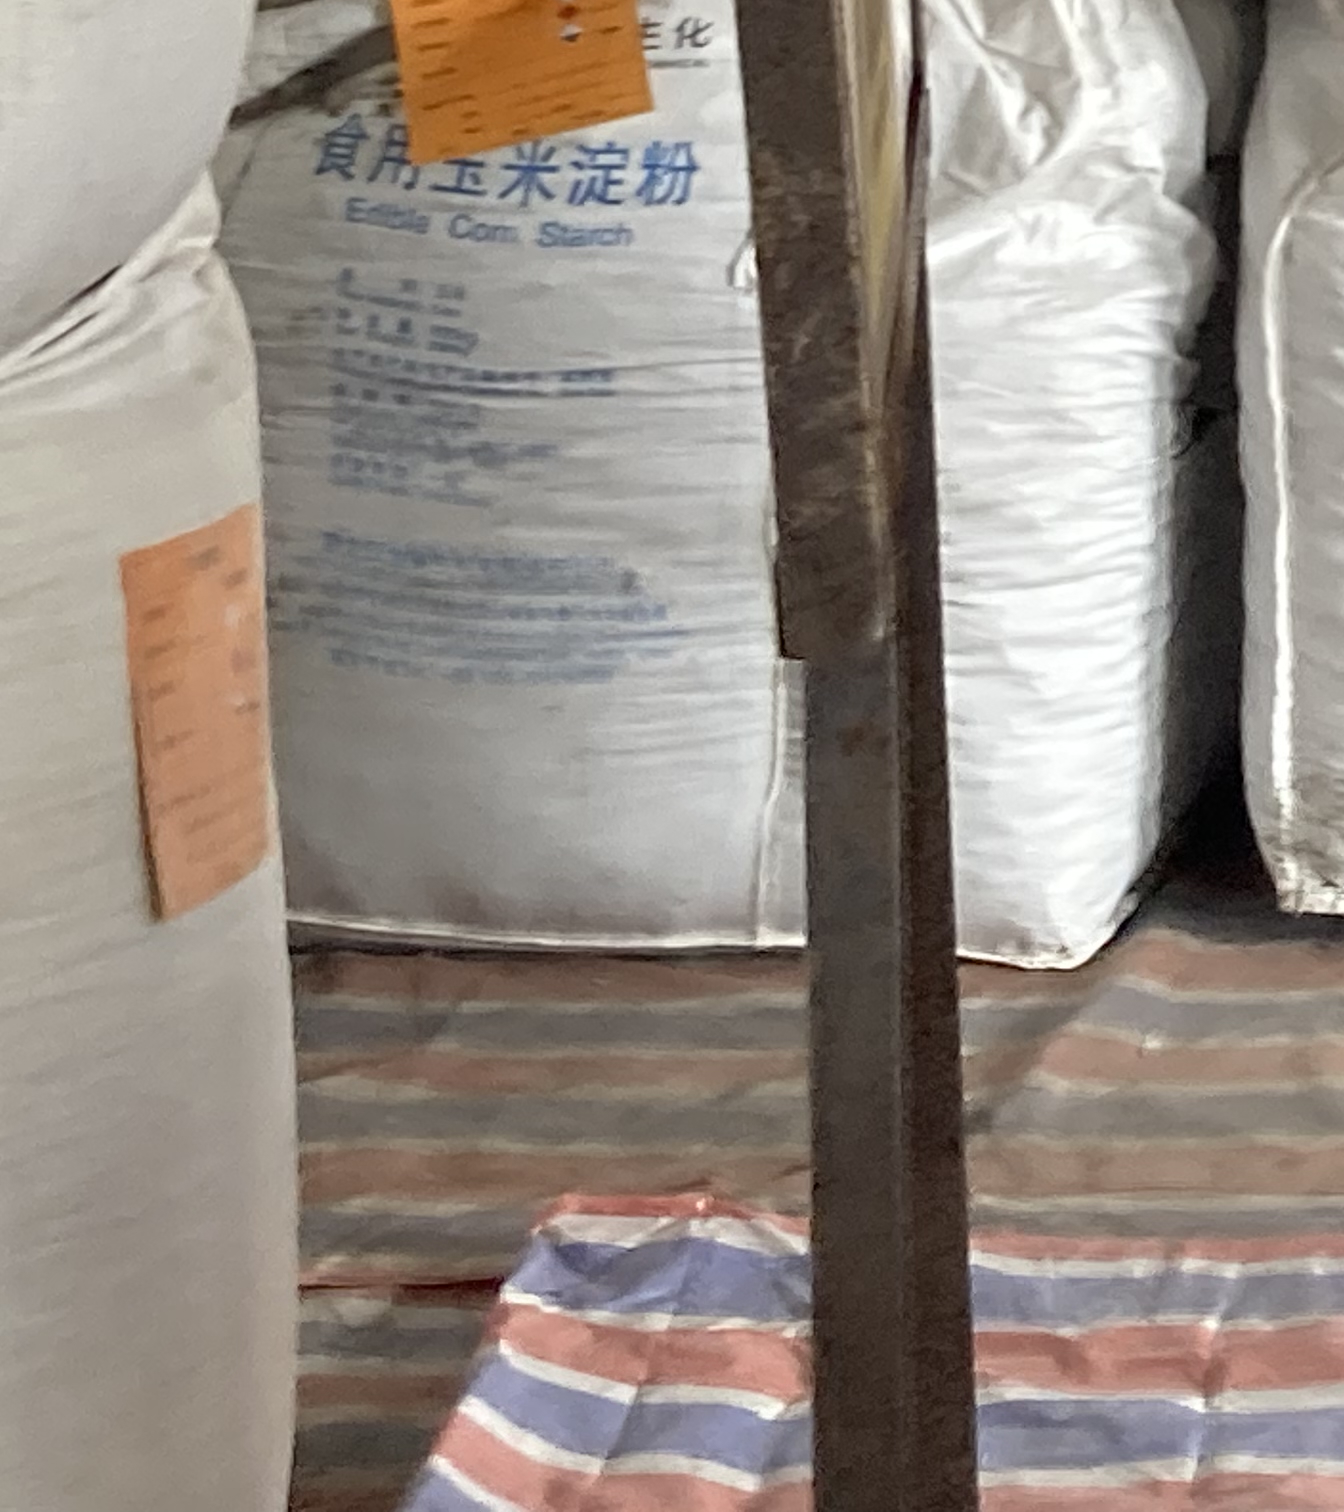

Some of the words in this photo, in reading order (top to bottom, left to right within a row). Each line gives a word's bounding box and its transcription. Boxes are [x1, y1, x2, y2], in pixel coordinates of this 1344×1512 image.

[313, 113, 703, 210] 食用玉米淀粉
[536, 220, 636, 249] Starch
